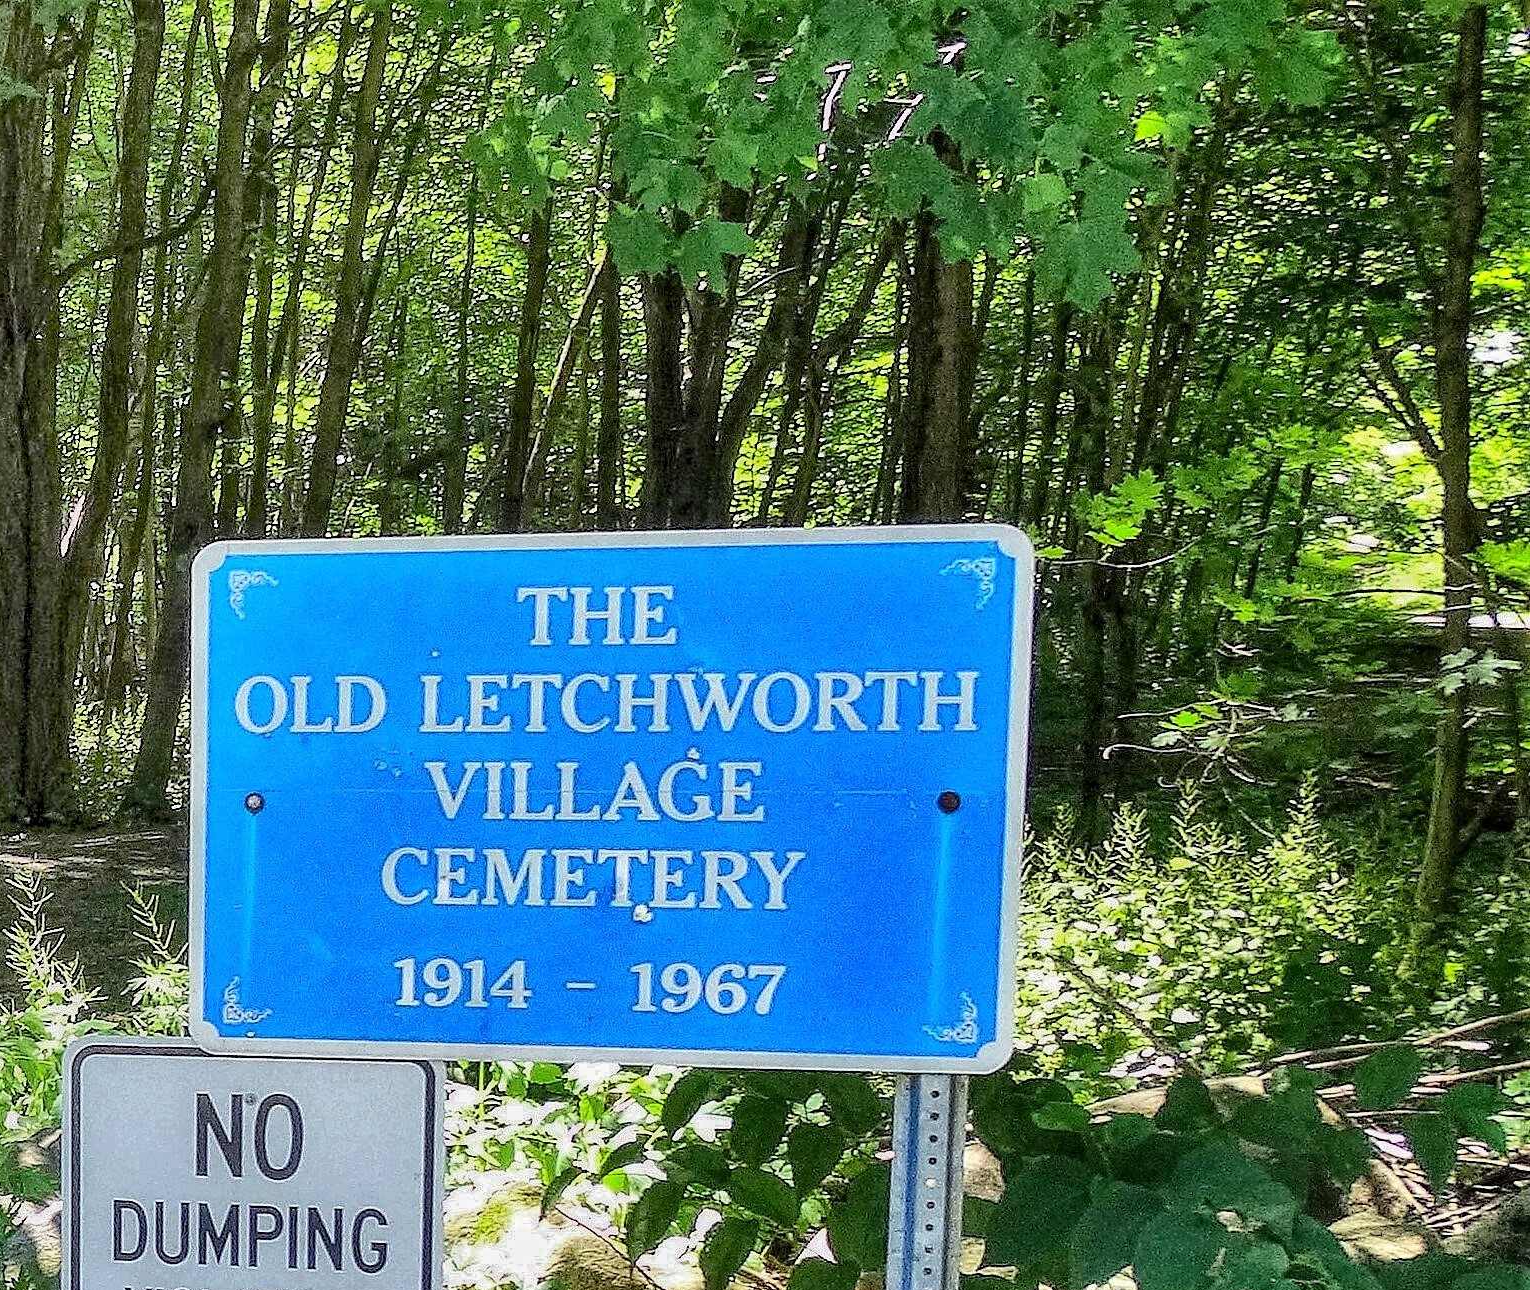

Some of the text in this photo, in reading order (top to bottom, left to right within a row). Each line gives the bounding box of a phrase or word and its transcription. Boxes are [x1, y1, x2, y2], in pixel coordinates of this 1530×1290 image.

[516, 585, 678, 647] THE
[235, 671, 979, 735] OLD LETCHWORTH
[424, 760, 765, 823] VILLAGE
[381, 849, 806, 911] CEMETERY
[394, 957, 533, 1010] 1914
[631, 961, 787, 1015] 1967
[195, 1092, 305, 1181] NO
[112, 1199, 390, 1275] DUMPING
